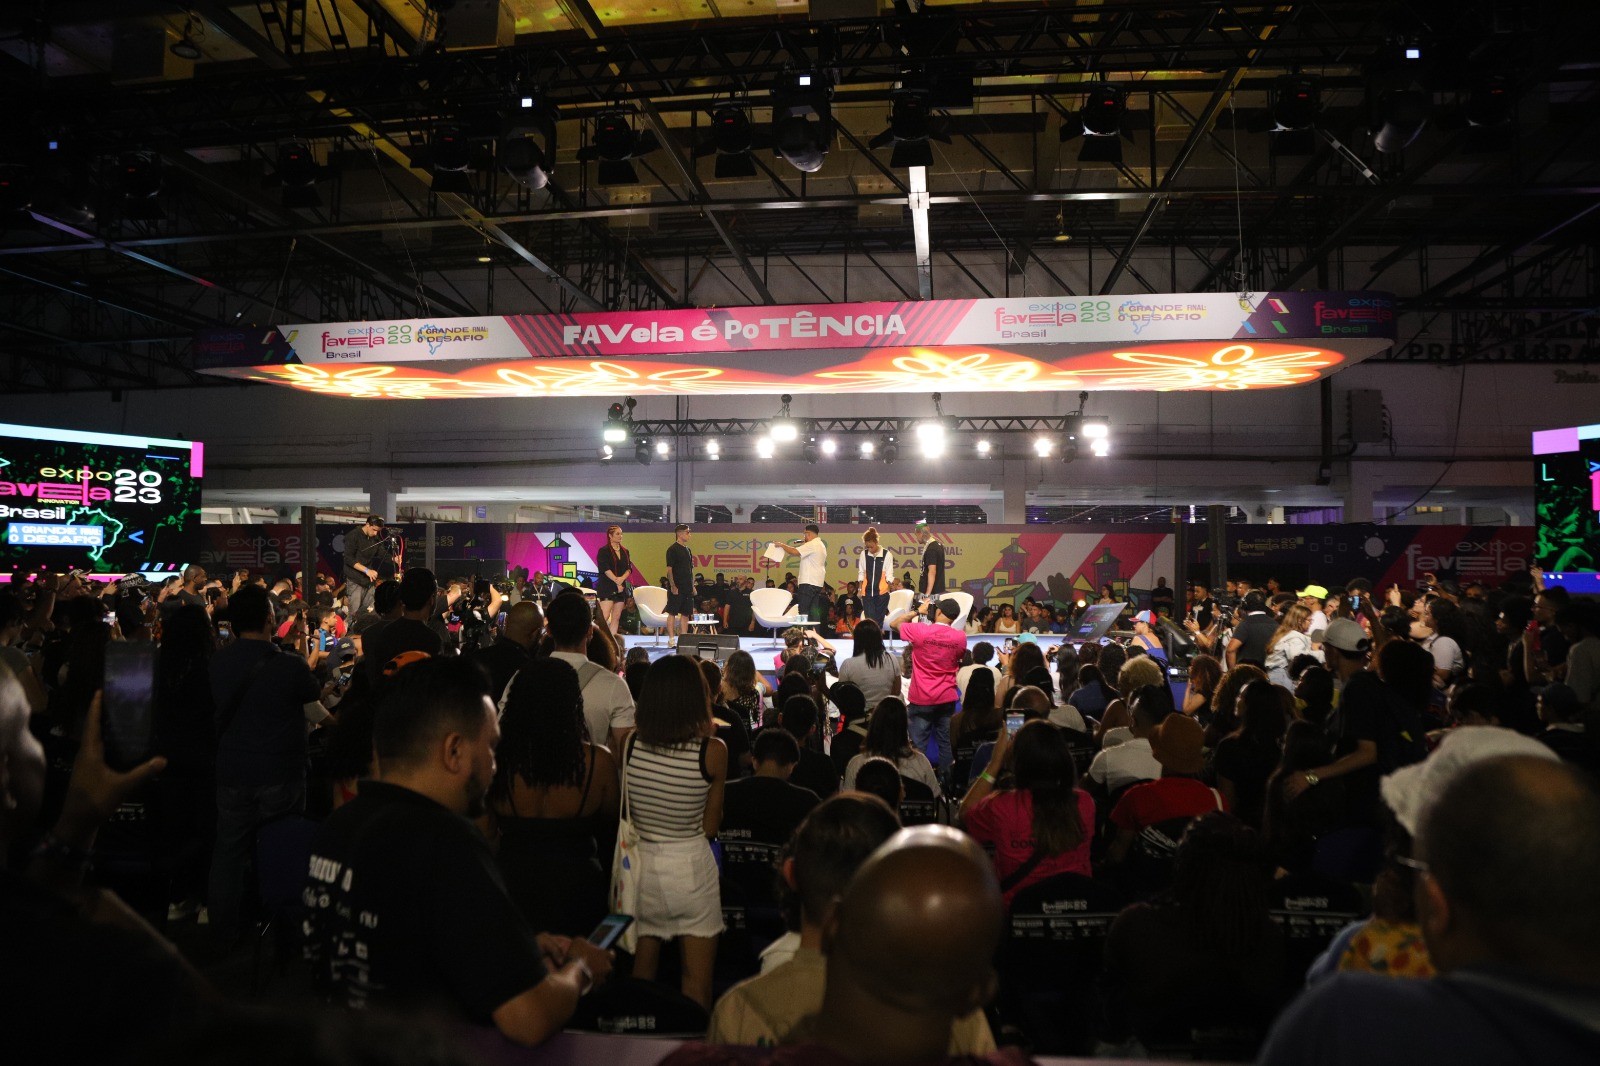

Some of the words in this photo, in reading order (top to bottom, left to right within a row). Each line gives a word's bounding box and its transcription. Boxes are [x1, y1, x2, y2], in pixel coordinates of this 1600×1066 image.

[1029, 303, 1076, 312] expo
[1080, 301, 1110, 311] 20
[1128, 304, 1182, 312] GRANDE
[1080, 312, 1110, 322] 23
[1130, 313, 1201, 321] DESAFIO
[347, 327, 385, 336] expo
[388, 325, 411, 334] 20
[426, 326, 469, 334] GRANDE
[691, 319, 718, 341] é
[1002, 329, 1046, 338] Brasil
[388, 335, 411, 344] 23
[426, 334, 484, 343] DESAFIO
[326, 351, 361, 359] Brasil
[40, 467, 113, 482] expo
[115, 468, 162, 487] 20
[115, 486, 162, 504] 23
[10, 525, 18, 533] A
[22, 525, 77, 535] GRANDE
[9, 534, 19, 542] O
[23, 534, 101, 544] DESAFIO
[227, 536, 280, 549] expo
[838, 546, 847, 555] A
[1456, 541, 1526, 555] expo
[838, 559, 848, 569] O
